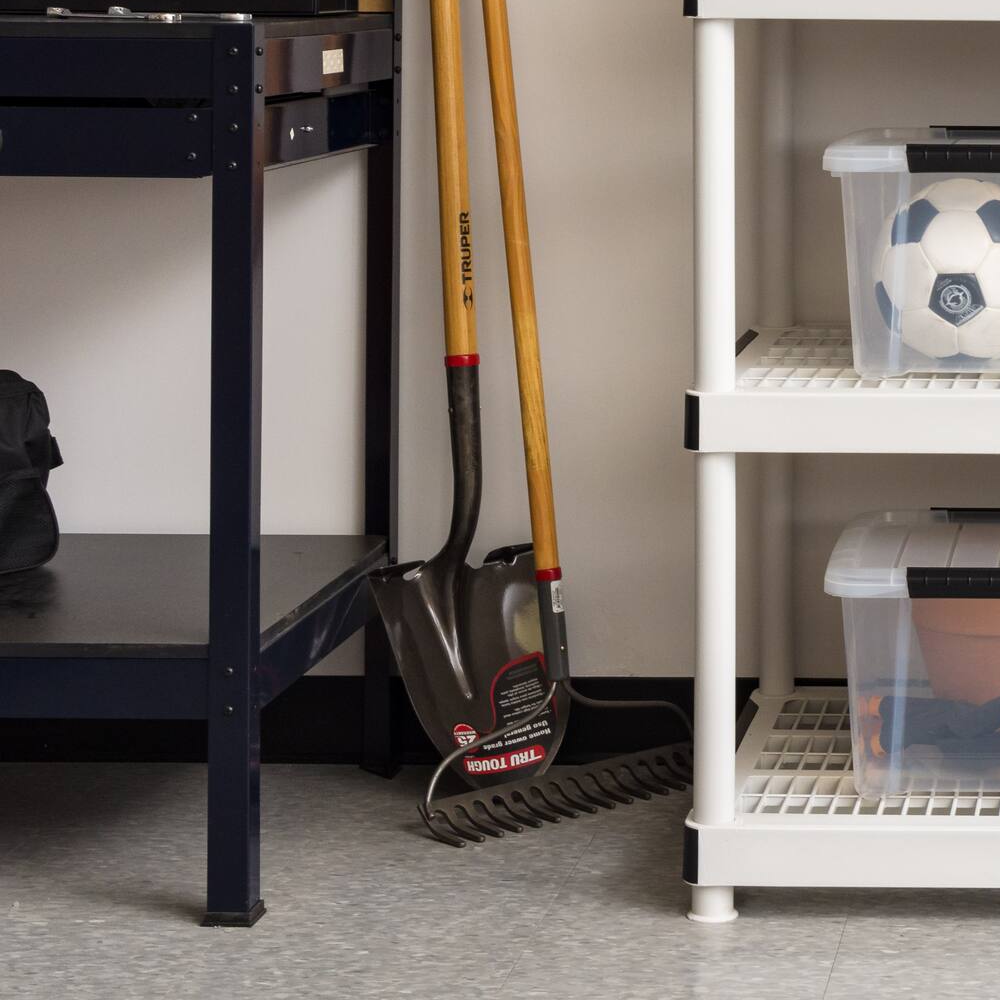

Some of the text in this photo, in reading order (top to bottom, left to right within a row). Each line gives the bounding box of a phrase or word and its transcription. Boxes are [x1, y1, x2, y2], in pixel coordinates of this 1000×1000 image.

[459, 211, 473, 285] TRUPER
[504, 735, 528, 747] owner
[528, 727, 551, 740] Home
[467, 749, 542, 772] TRU TOUGH
